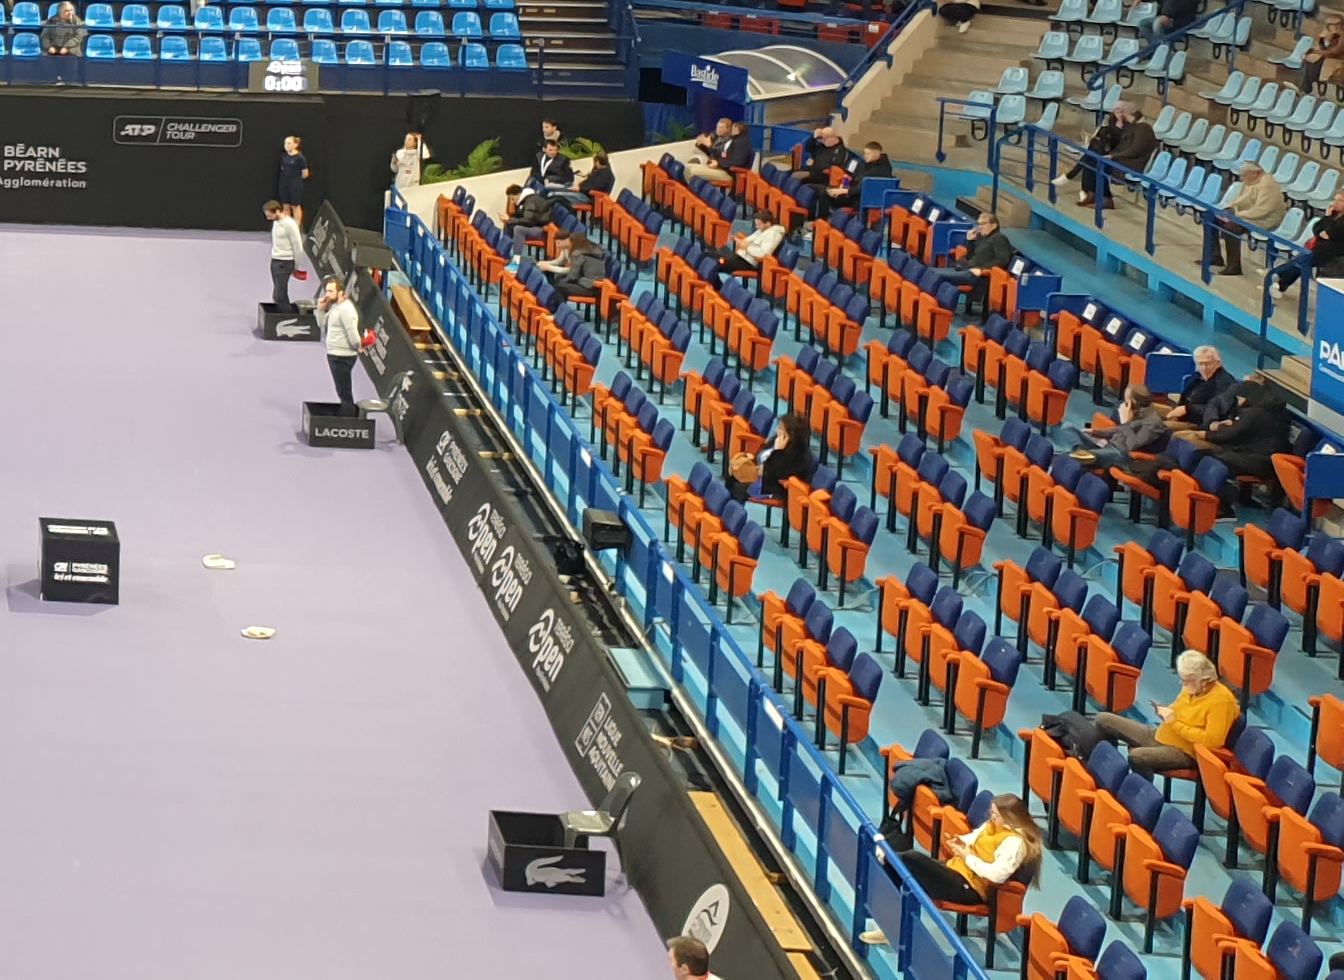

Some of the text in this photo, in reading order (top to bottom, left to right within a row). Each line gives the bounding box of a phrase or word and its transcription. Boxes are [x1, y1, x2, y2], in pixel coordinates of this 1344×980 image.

[120, 123, 156, 136] ATP
[165, 130, 196, 140] TOUR
[166, 123, 237, 133] CHALLENGER
[1319, 339, 1344, 371] PA
[314, 427, 369, 439] LACOSTE
[468, 502, 498, 566] Open
[491, 545, 524, 613] Open
[528, 608, 565, 683] Open
[604, 715, 624, 750] LIGUE
[587, 744, 617, 793] AQUITAIN
[595, 730, 625, 778] NOUVELLE
